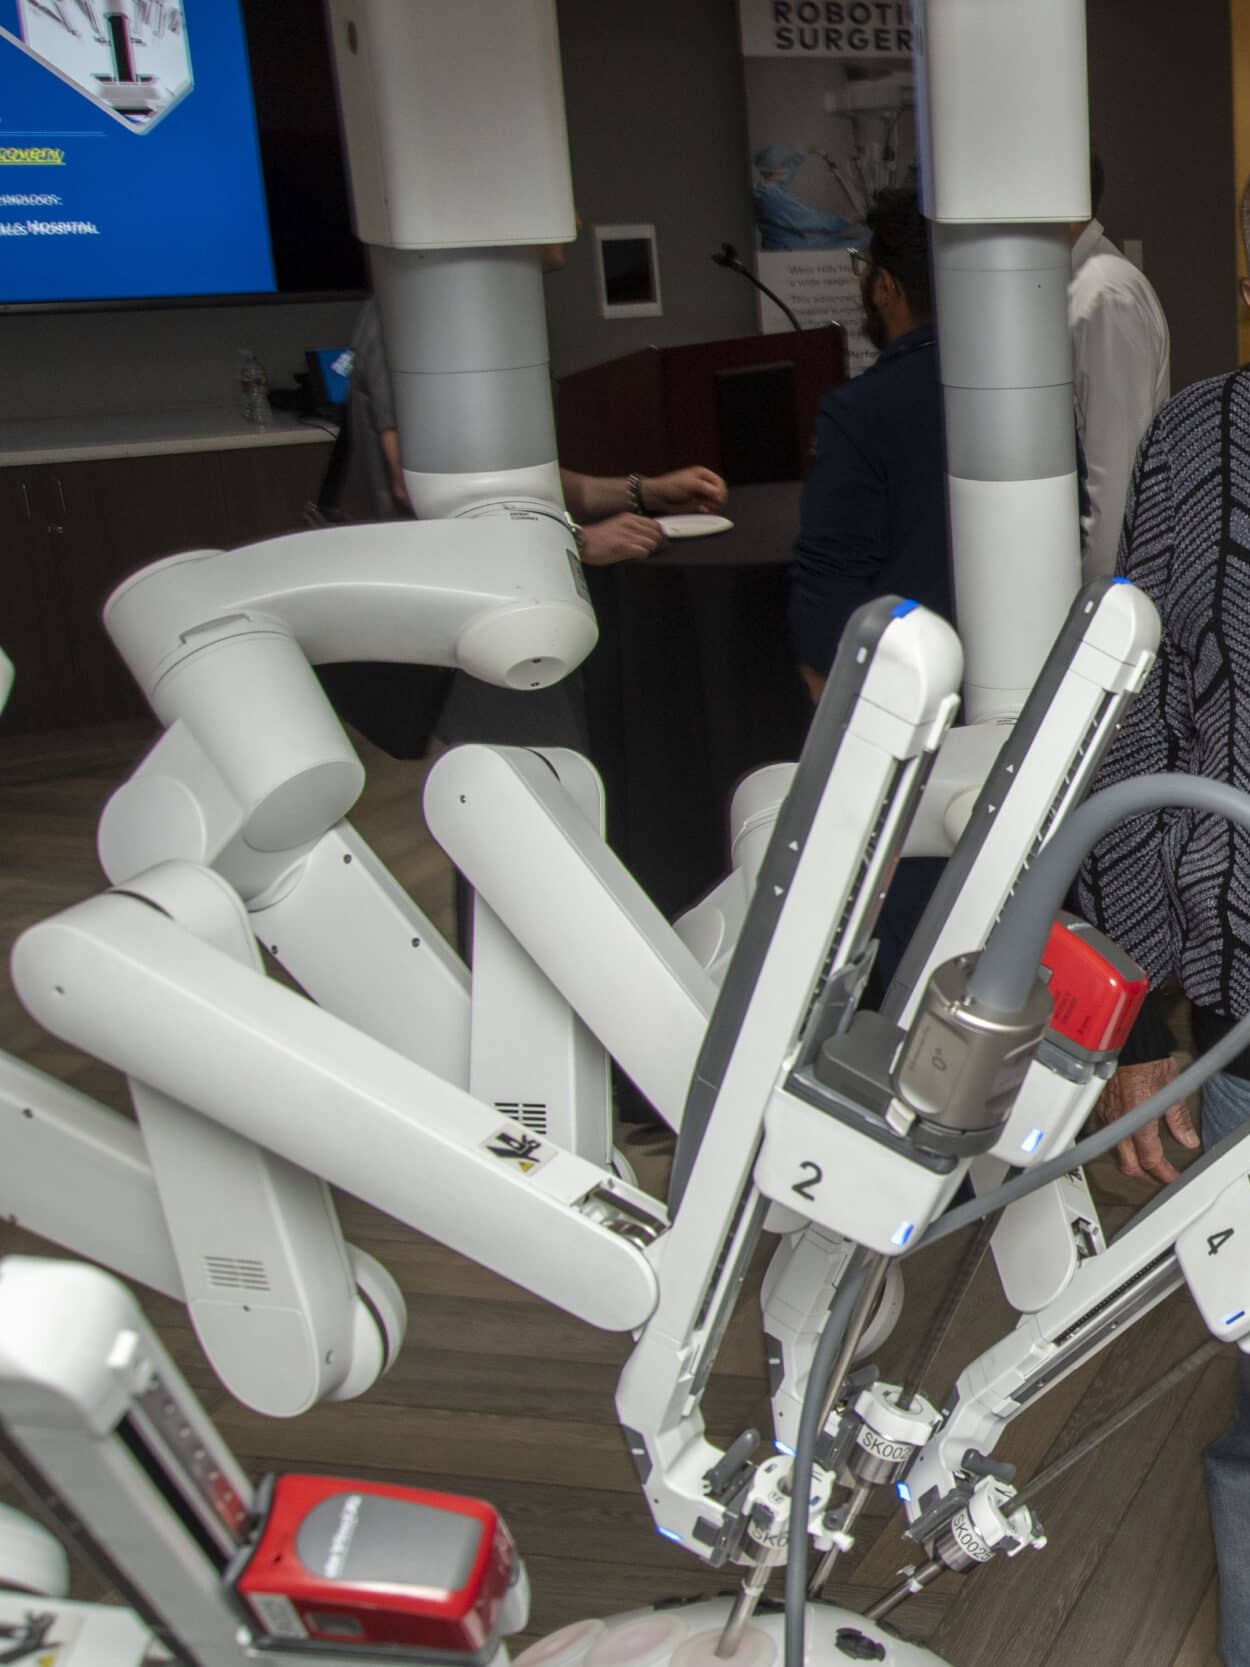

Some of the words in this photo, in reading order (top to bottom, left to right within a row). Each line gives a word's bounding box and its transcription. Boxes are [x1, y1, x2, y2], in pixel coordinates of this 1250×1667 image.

[774, 1, 911, 25] ROBOTI
[776, 28, 912, 50] SURGER
[792, 1161, 822, 1202] 2
[1207, 1228, 1234, 1256] 4
